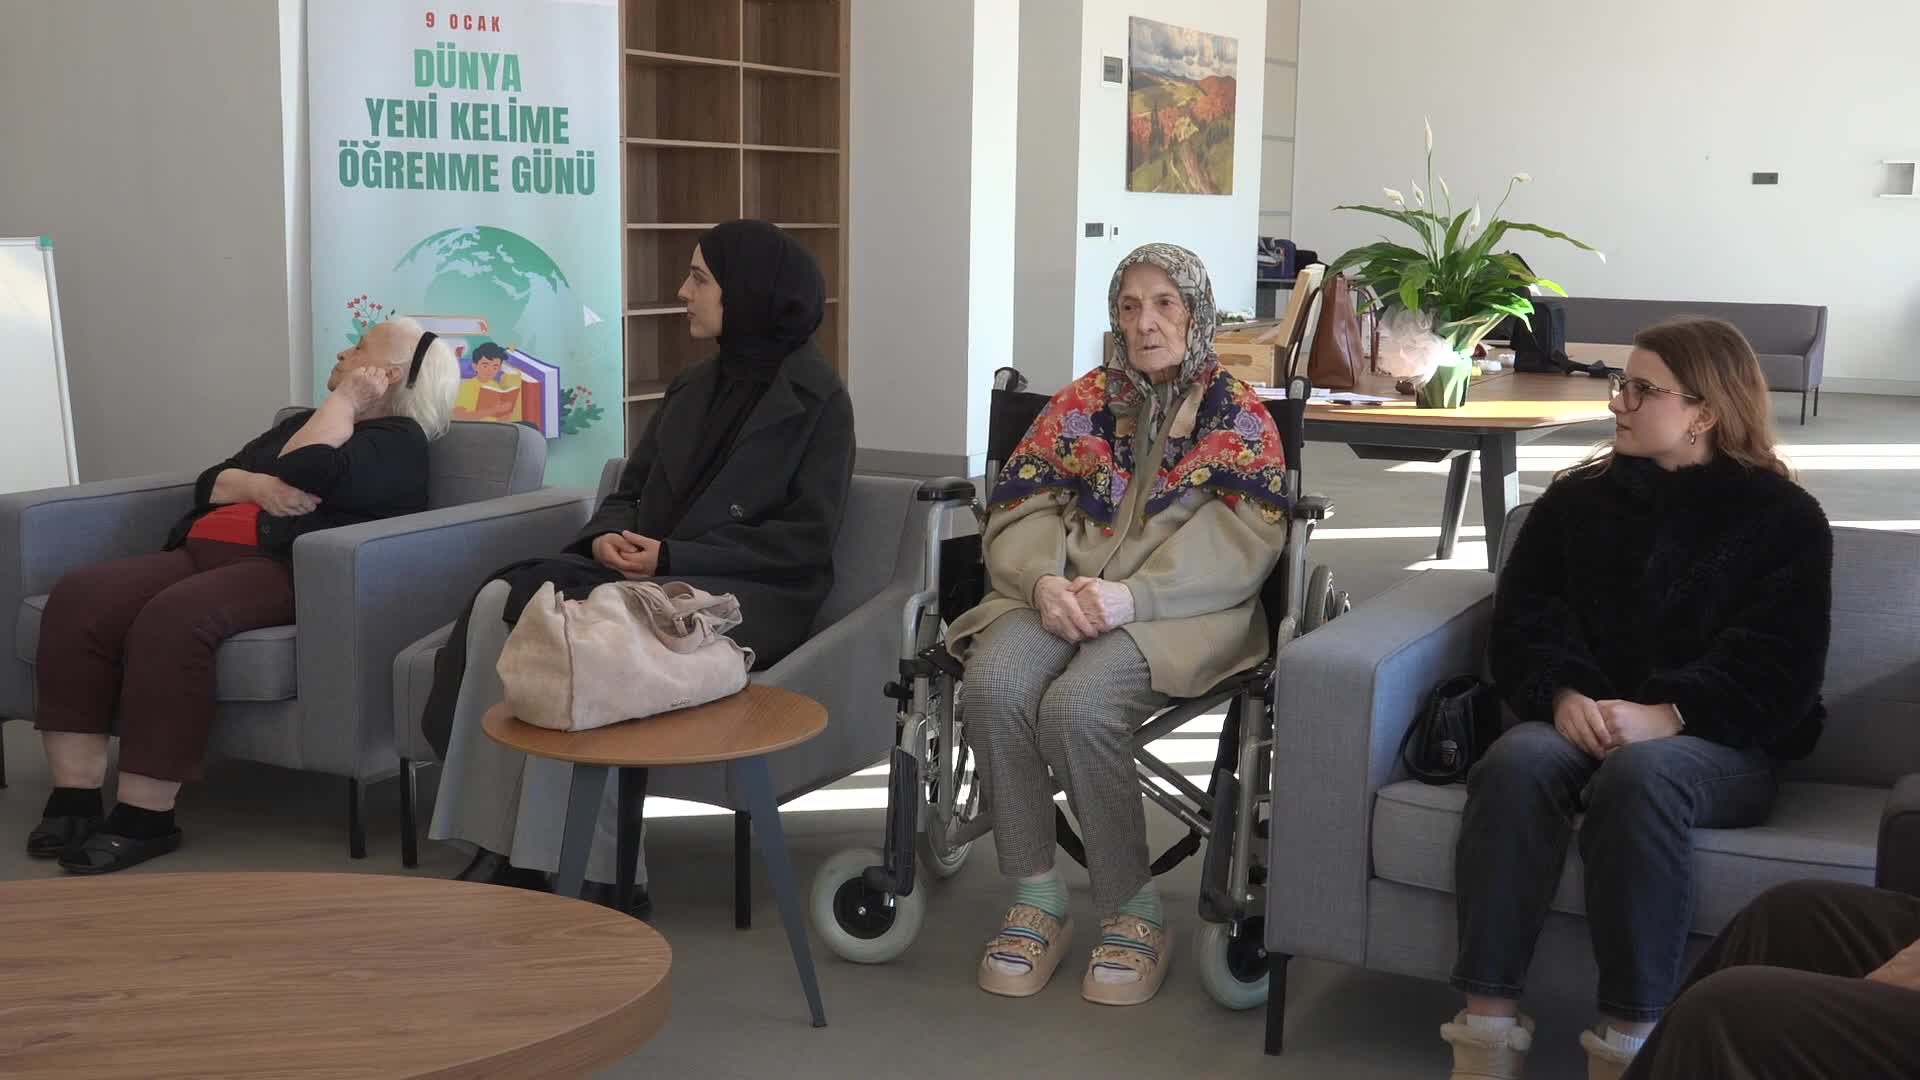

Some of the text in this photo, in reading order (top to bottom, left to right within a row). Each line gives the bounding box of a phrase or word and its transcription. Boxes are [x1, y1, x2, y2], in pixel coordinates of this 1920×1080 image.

[425, 12, 501, 32] 9 OCAK
[414, 41, 522, 92] DÜNYA
[365, 92, 569, 145] YENİ KELİME
[338, 139, 596, 196] ÖĞRENME GÜNÜ
